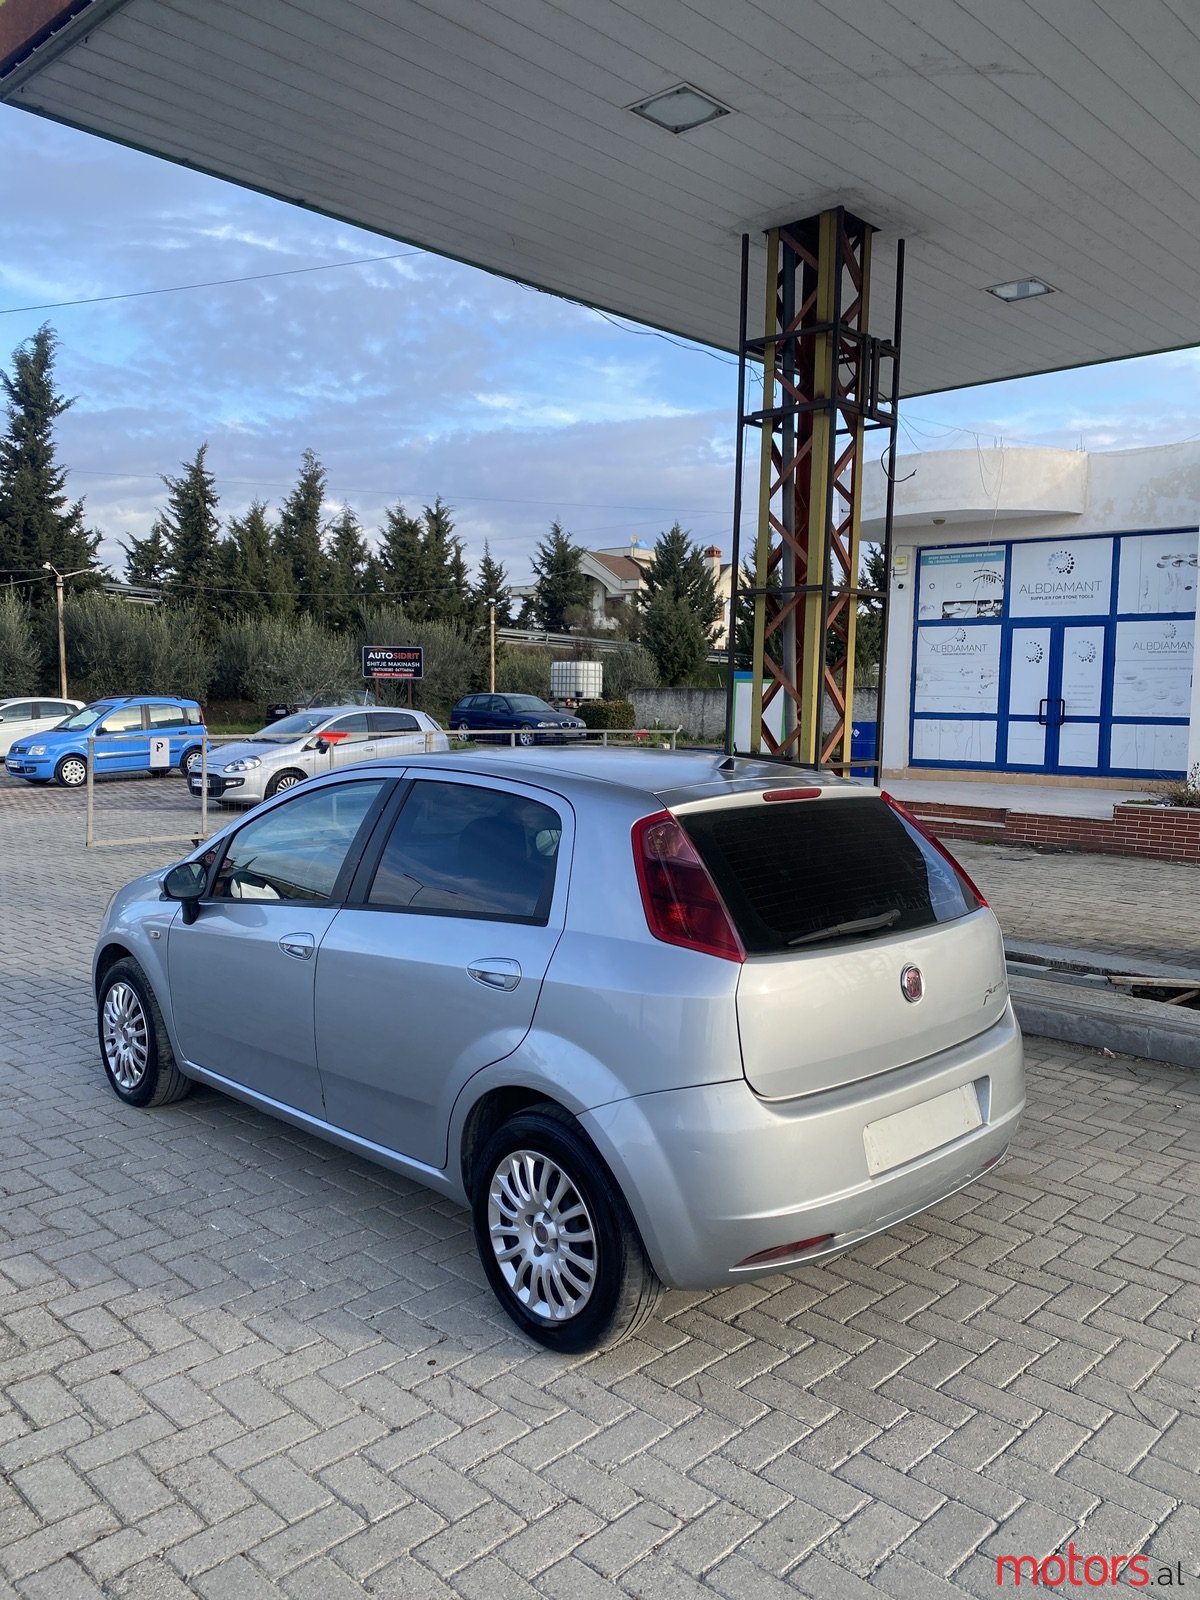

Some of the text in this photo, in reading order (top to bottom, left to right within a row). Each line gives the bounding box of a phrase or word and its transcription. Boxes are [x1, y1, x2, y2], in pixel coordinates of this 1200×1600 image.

[1019, 580, 1103, 594] ALBDIAMANT
[930, 643, 988, 653] ALBDIAMANT
[1133, 641, 1194, 651] ALBDIAMAN
